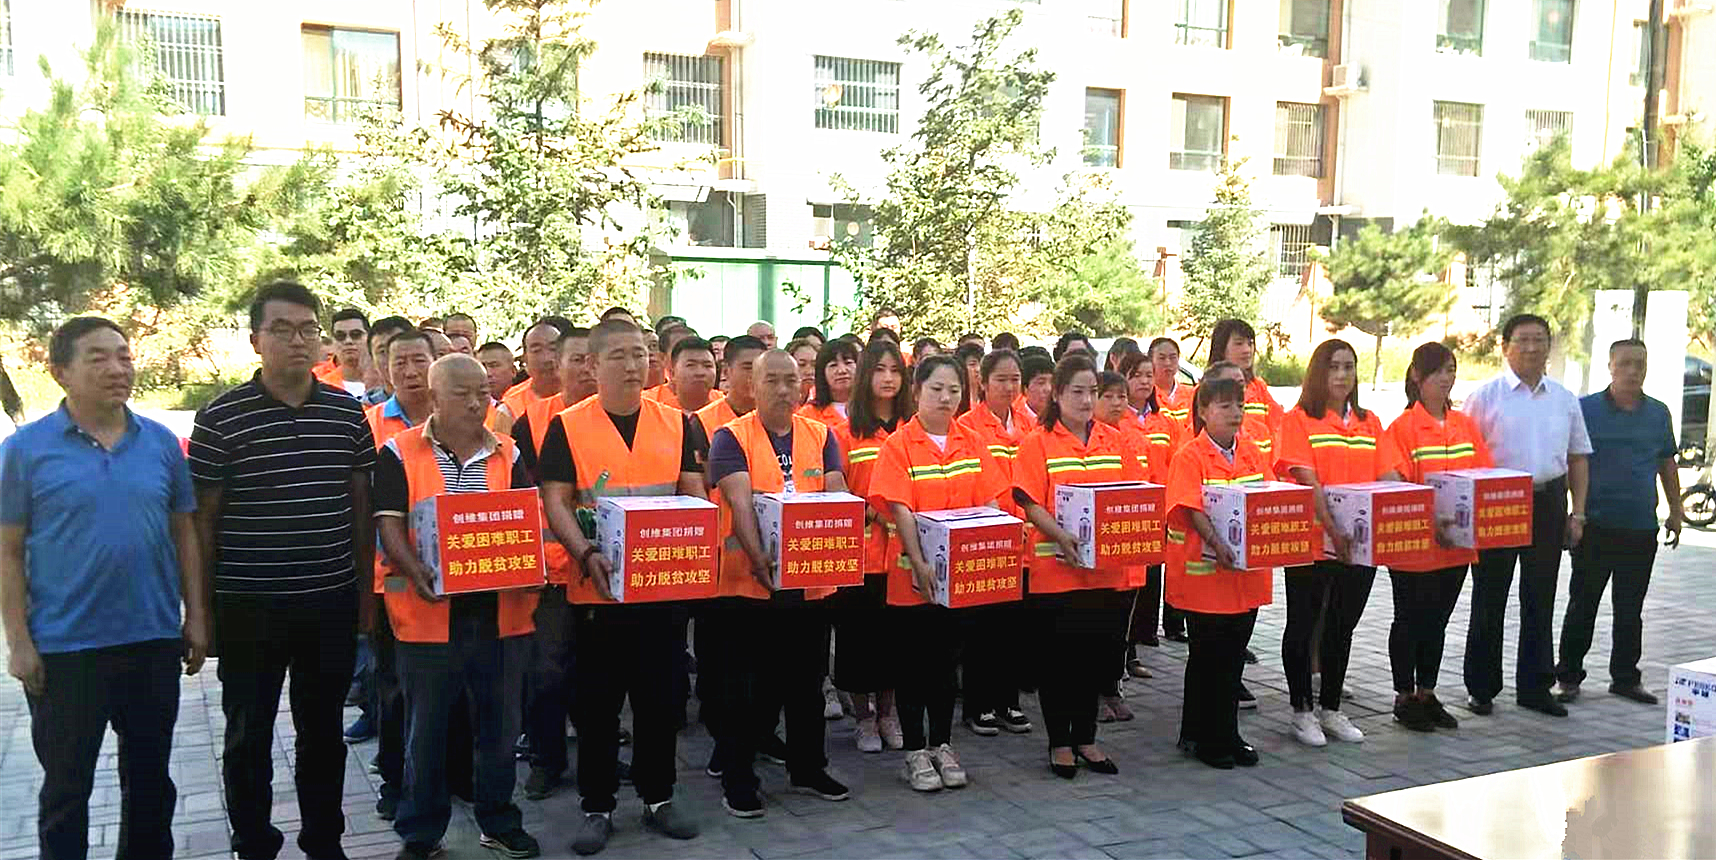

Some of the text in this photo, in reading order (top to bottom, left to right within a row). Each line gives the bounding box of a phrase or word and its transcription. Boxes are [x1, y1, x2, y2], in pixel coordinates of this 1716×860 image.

[453, 509, 524, 524] 创维集团捐赠
[640, 526, 704, 538] 创维集团捐赠
[1100, 520, 1161, 535] 关爱困难职工
[447, 529, 535, 549] 关爱困难职工
[787, 536, 859, 552] 关爱困难职工
[631, 546, 711, 562] 关爱困难职工
[1100, 540, 1162, 556] 助力脱贫攻坚
[449, 555, 537, 576] 助力脱贫攻坚
[787, 559, 858, 574] 助力脱贫攻坚
[954, 555, 1017, 574] 关爱困难职工
[631, 569, 711, 587] 助力脱贫攻坚
[954, 576, 1017, 594] 助力脱贫攻坚
